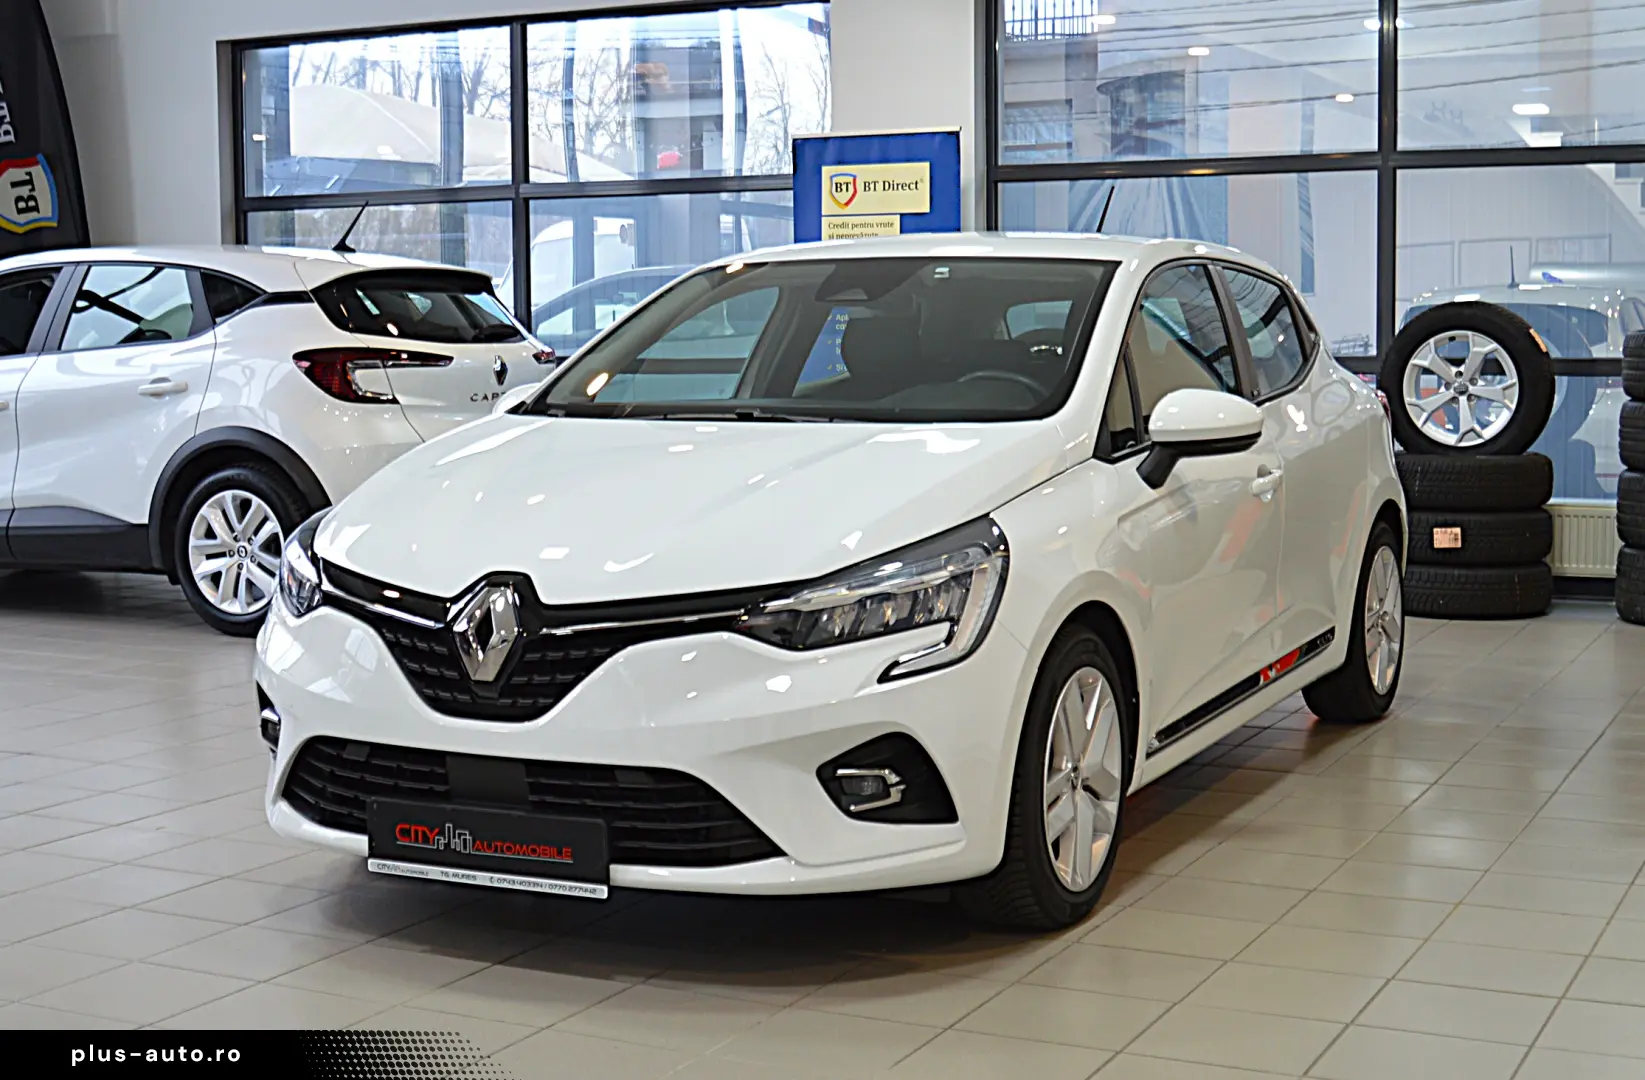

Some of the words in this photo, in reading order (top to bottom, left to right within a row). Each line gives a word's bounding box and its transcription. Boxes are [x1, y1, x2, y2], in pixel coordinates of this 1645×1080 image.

[834, 181, 851, 193] BT
[863, 181, 880, 192] BT
[882, 180, 919, 192] Direct
[10, 171, 40, 215] BT
[828, 221, 850, 229] Credit
[851, 222, 874, 231] pentru
[875, 221, 894, 229] vrute
[470, 391, 506, 402] CAP
[395, 823, 440, 844] CITY
[472, 840, 572, 859] AUTOMOBILE
